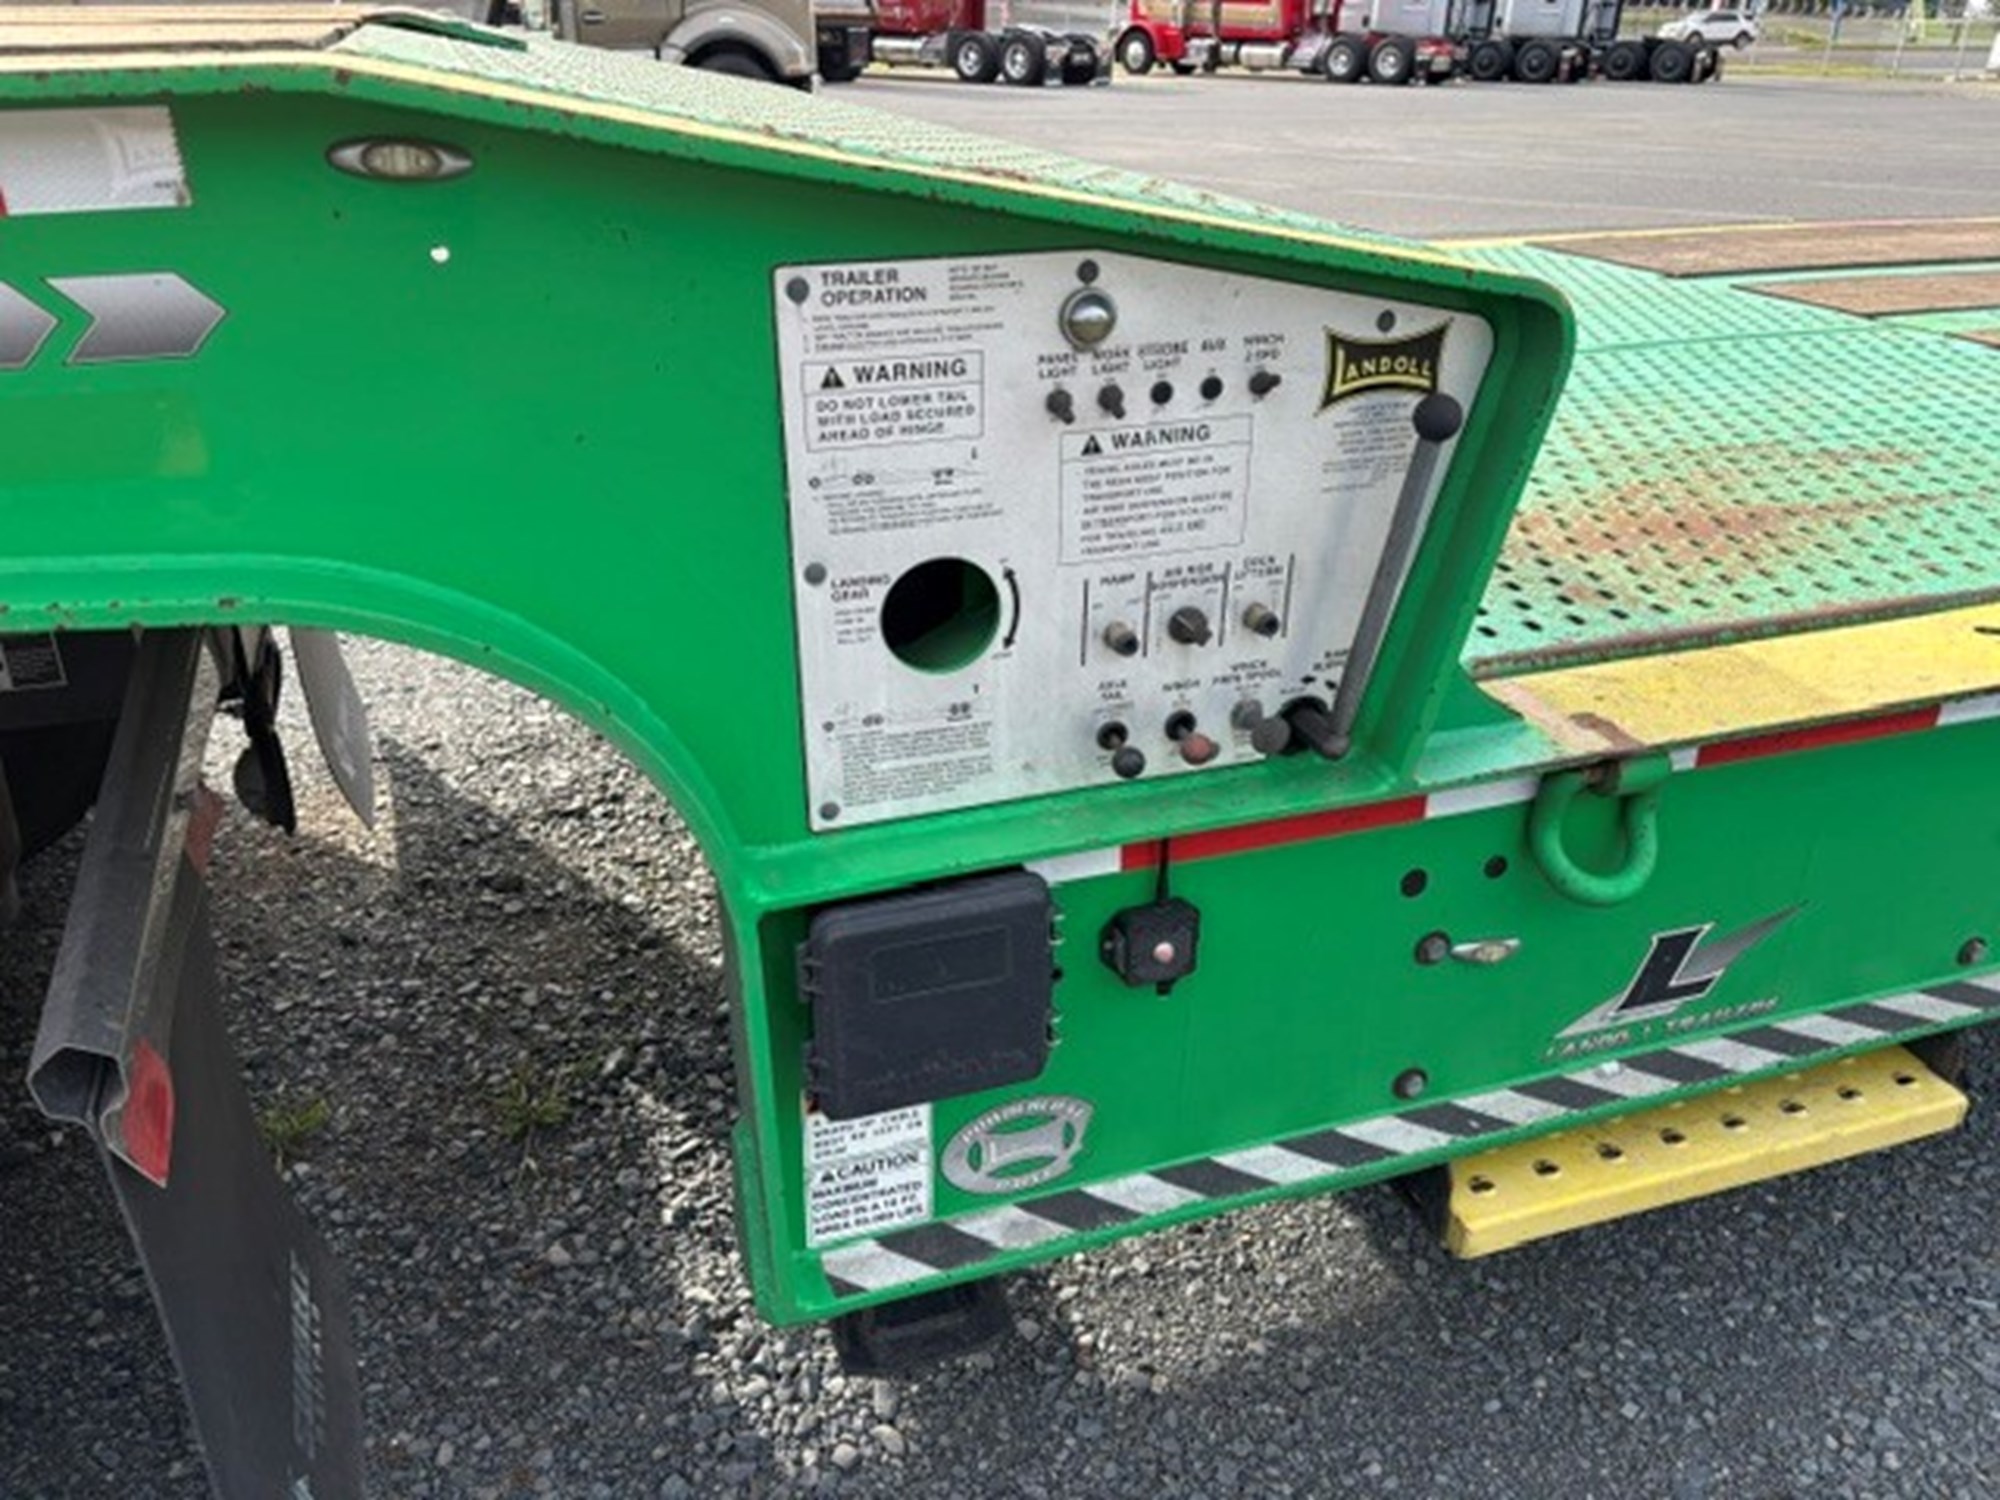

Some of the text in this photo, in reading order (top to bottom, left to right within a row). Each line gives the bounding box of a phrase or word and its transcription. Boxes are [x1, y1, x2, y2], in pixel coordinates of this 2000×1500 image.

[821, 268, 899, 287] TRAILER
[821, 286, 927, 307] OPERATION
[853, 358, 967, 383] WARNING
[1332, 348, 1432, 395] LANDOLL
[816, 399, 838, 413] DO
[843, 396, 873, 411] NOT
[878, 393, 932, 410] LOWER
[860, 409, 900, 425] LOAD
[818, 428, 870, 443] AHEAD
[1112, 424, 1211, 450] WARNING
[837, 1149, 919, 1181] CAUTION
